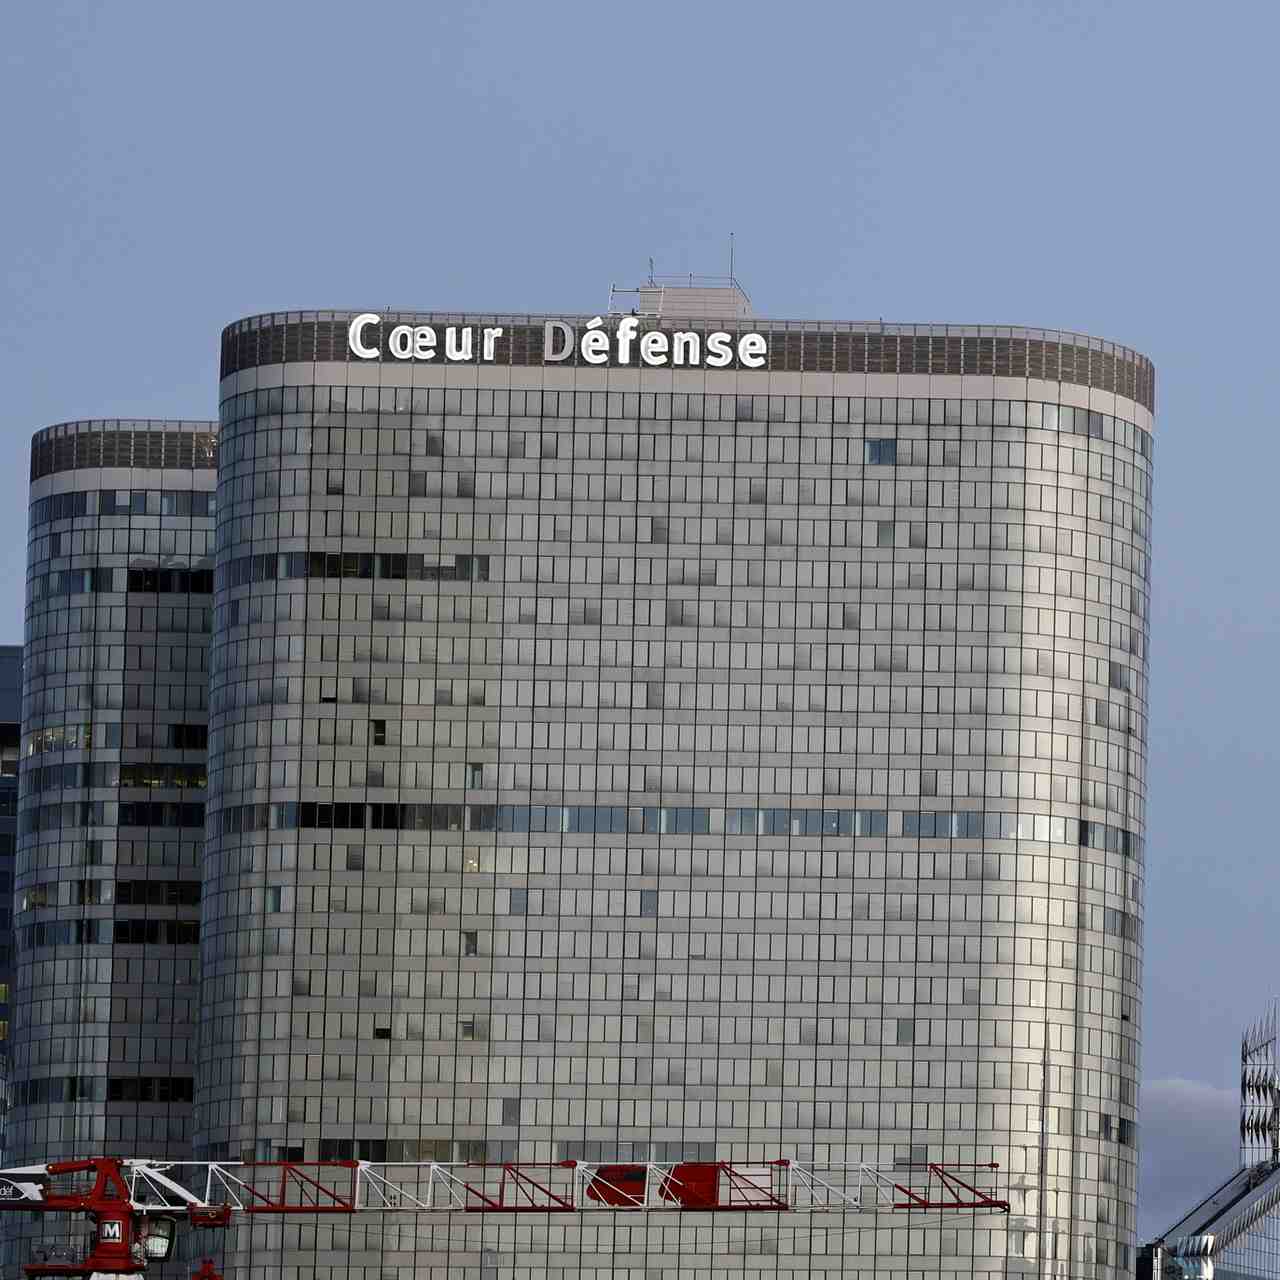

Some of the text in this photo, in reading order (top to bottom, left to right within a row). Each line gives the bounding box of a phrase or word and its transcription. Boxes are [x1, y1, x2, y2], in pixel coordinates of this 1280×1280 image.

[348, 313, 768, 368] Cœur Défense
[104, 1223, 119, 1238] M
